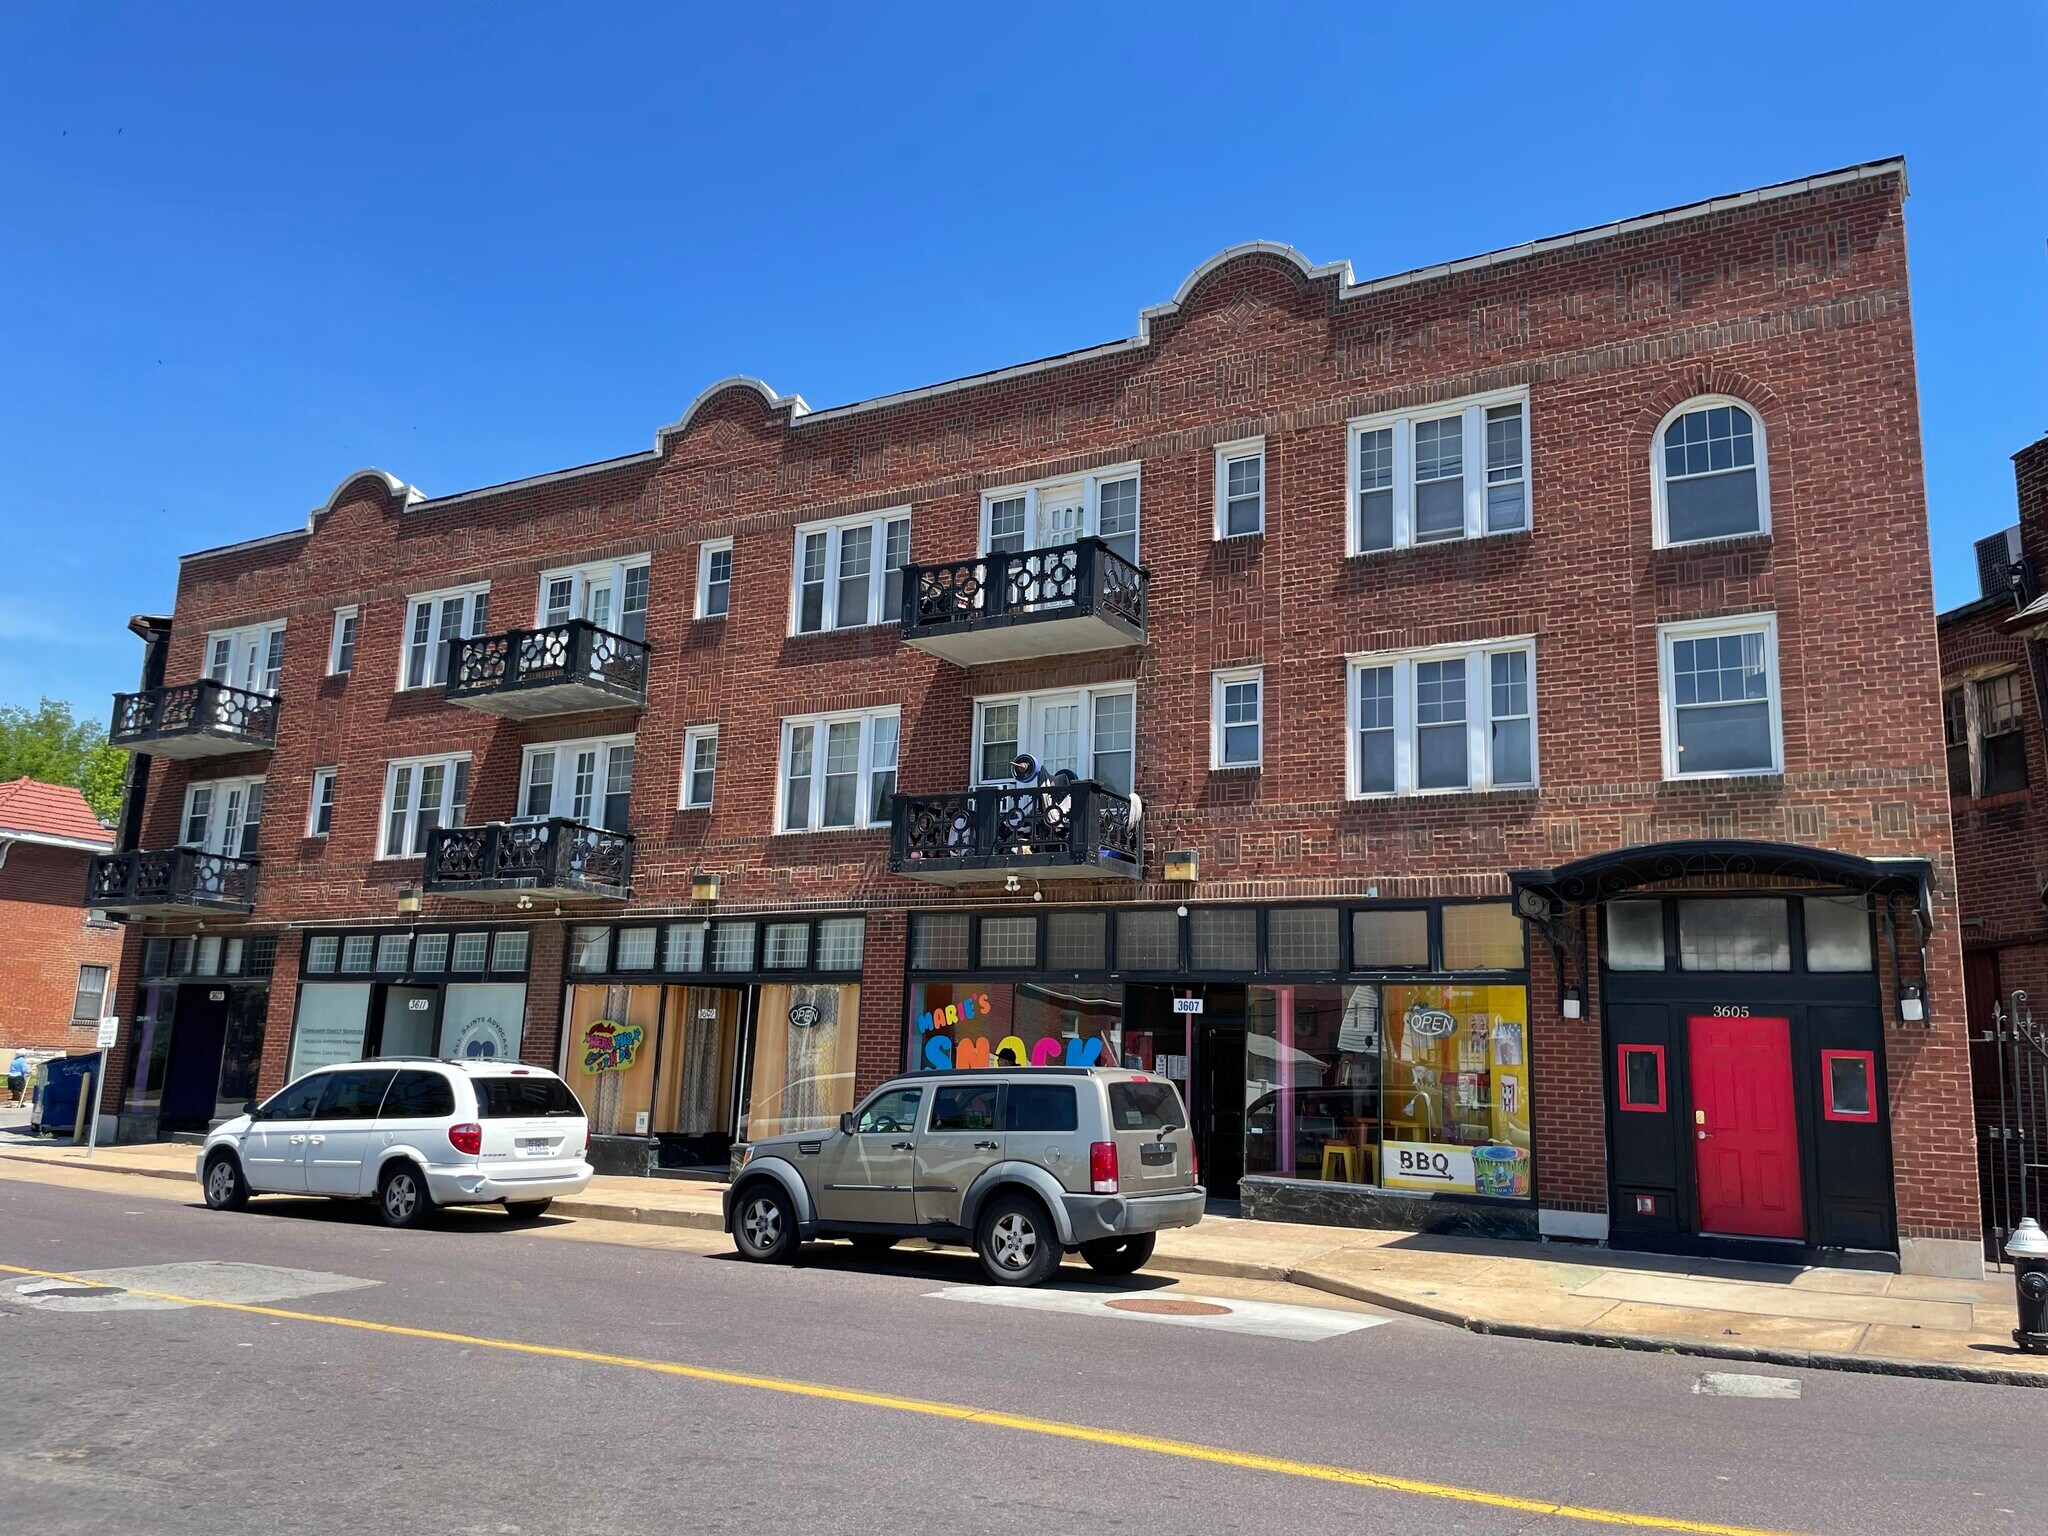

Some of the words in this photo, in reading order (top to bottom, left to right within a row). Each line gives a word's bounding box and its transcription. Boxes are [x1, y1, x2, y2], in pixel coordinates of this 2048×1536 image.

[410, 1000, 427, 1010] 3611
[1177, 1000, 1200, 1012] 3607
[1713, 1005, 1750, 1019] 3605
[790, 1008, 819, 1022] OPEN
[917, 993, 991, 1034] MARIE'S
[1410, 1014, 1454, 1032] OPEN
[453, 1037, 462, 1055] ALL
[461, 1016, 486, 1035] SAINTS
[486, 1016, 509, 1057] ADVOCACY
[1400, 1150, 1449, 1175] BBQ
